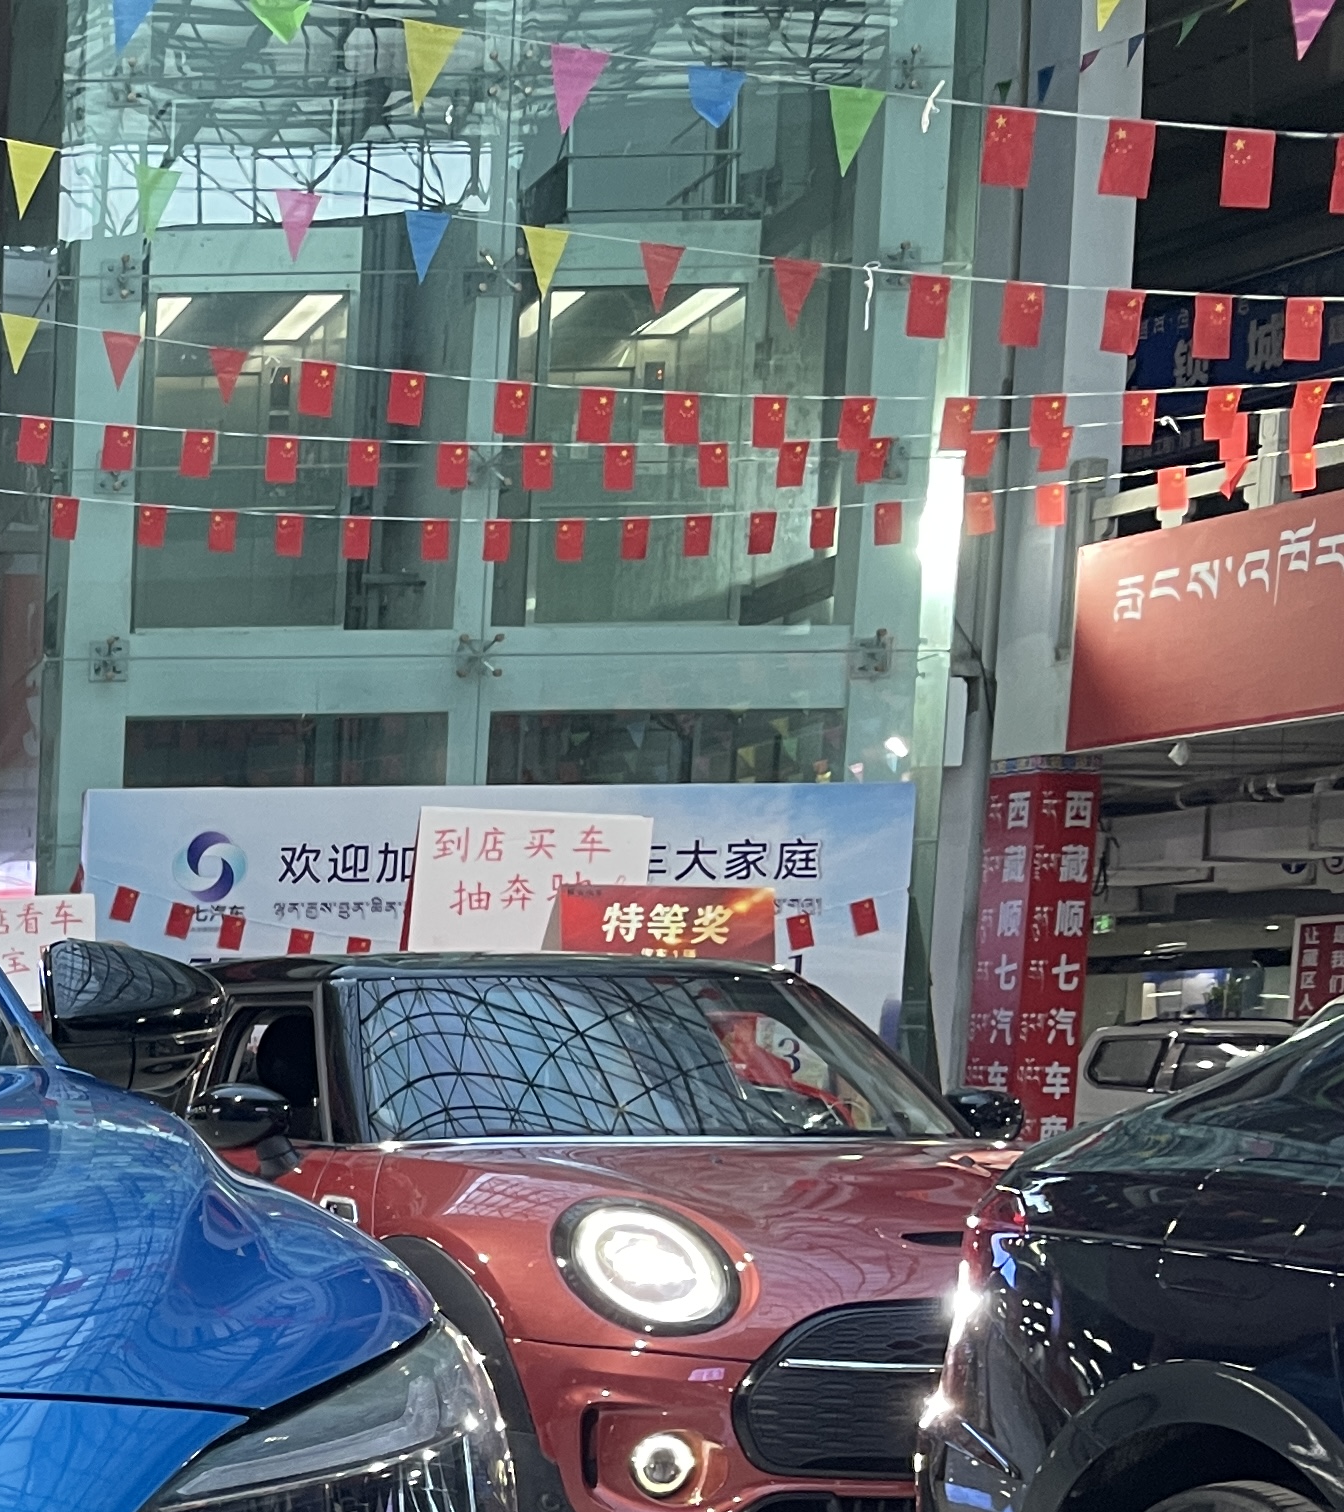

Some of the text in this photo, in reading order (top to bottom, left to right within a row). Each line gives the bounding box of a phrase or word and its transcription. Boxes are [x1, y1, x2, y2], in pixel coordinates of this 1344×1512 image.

[432, 825, 612, 864] 到店买车
[601, 902, 730, 944] 特等奖
